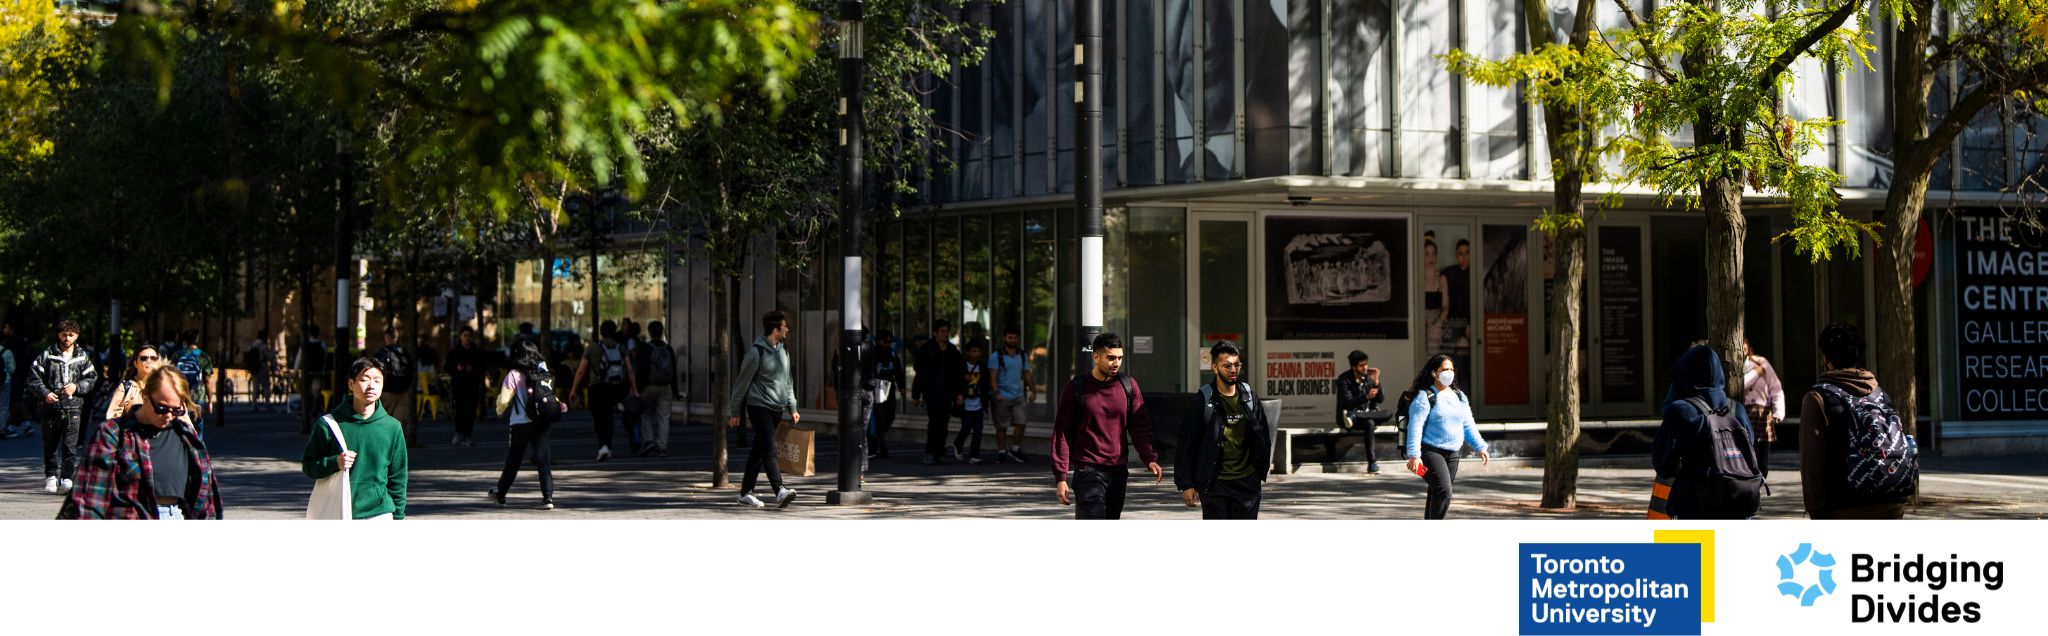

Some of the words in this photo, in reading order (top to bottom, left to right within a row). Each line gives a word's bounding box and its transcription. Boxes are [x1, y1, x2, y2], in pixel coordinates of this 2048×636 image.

[1961, 216, 2012, 241] THE
[1967, 250, 2048, 276] IMAGE
[1267, 362, 1302, 378] DEANNA
[1304, 361, 1335, 378] BOWEN
[1267, 380, 1295, 395] BLACK
[1297, 379, 1330, 395] DRONES
